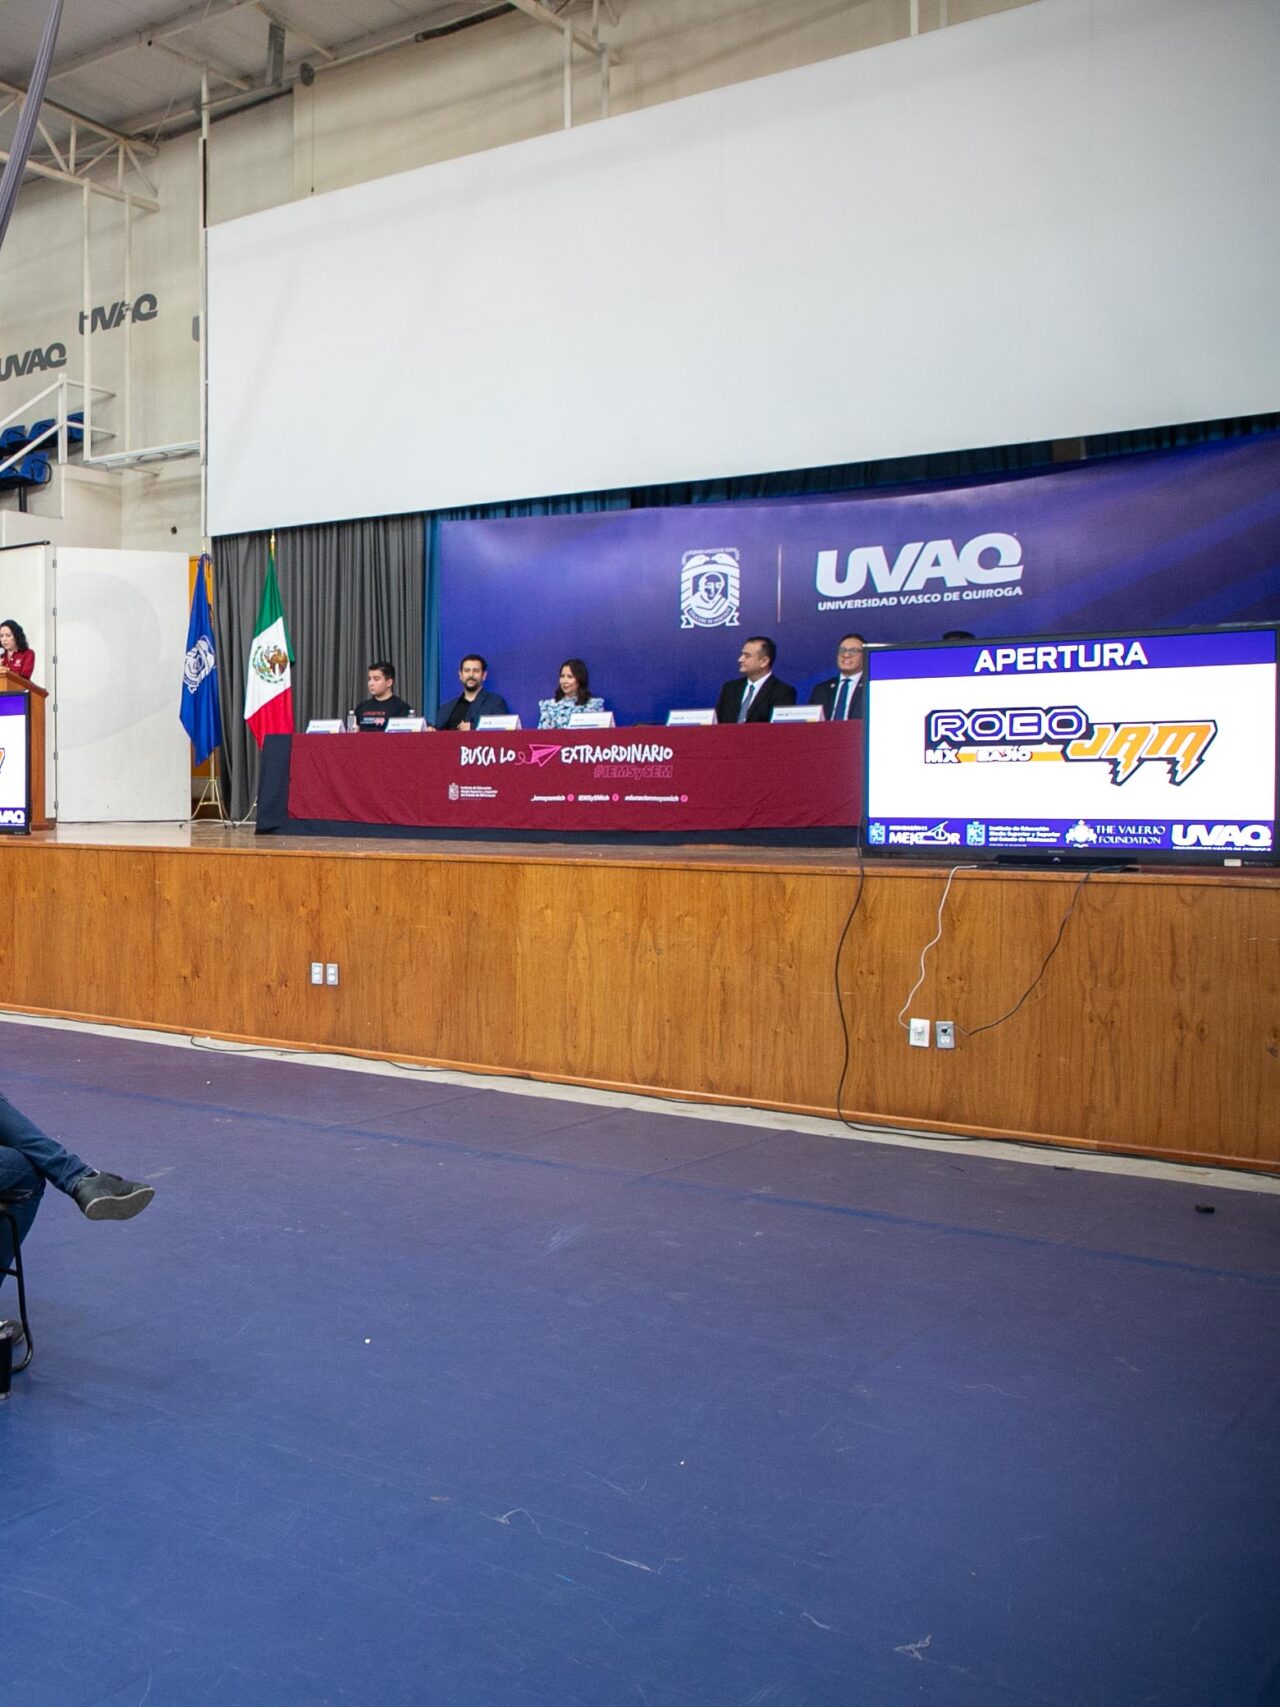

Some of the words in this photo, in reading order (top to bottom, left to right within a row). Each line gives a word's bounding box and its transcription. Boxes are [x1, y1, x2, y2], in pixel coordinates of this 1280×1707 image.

[815, 532, 1024, 598] UVAQ
[818, 597, 897, 611] UNIVERSIDAD
[899, 592, 941, 605] VASCO
[943, 591, 961, 602] DE
[962, 586, 1023, 600] QUIROGA
[974, 641, 1148, 673] APERTURA
[928, 706, 1088, 742] ROBO
[460, 745, 496, 767] BUSCA
[499, 746, 516, 765] LO
[560, 743, 674, 763] EXTRAORDINARIO
[925, 748, 960, 764] MX
[1066, 720, 1217, 785] JAM
[593, 765, 673, 781] #IEMSySEM
[1097, 825, 1116, 834] THE
[1118, 825, 1166, 835] VALERIO
[1099, 836, 1161, 845] FOUNDATION
[1172, 824, 1272, 847] UVAQ
